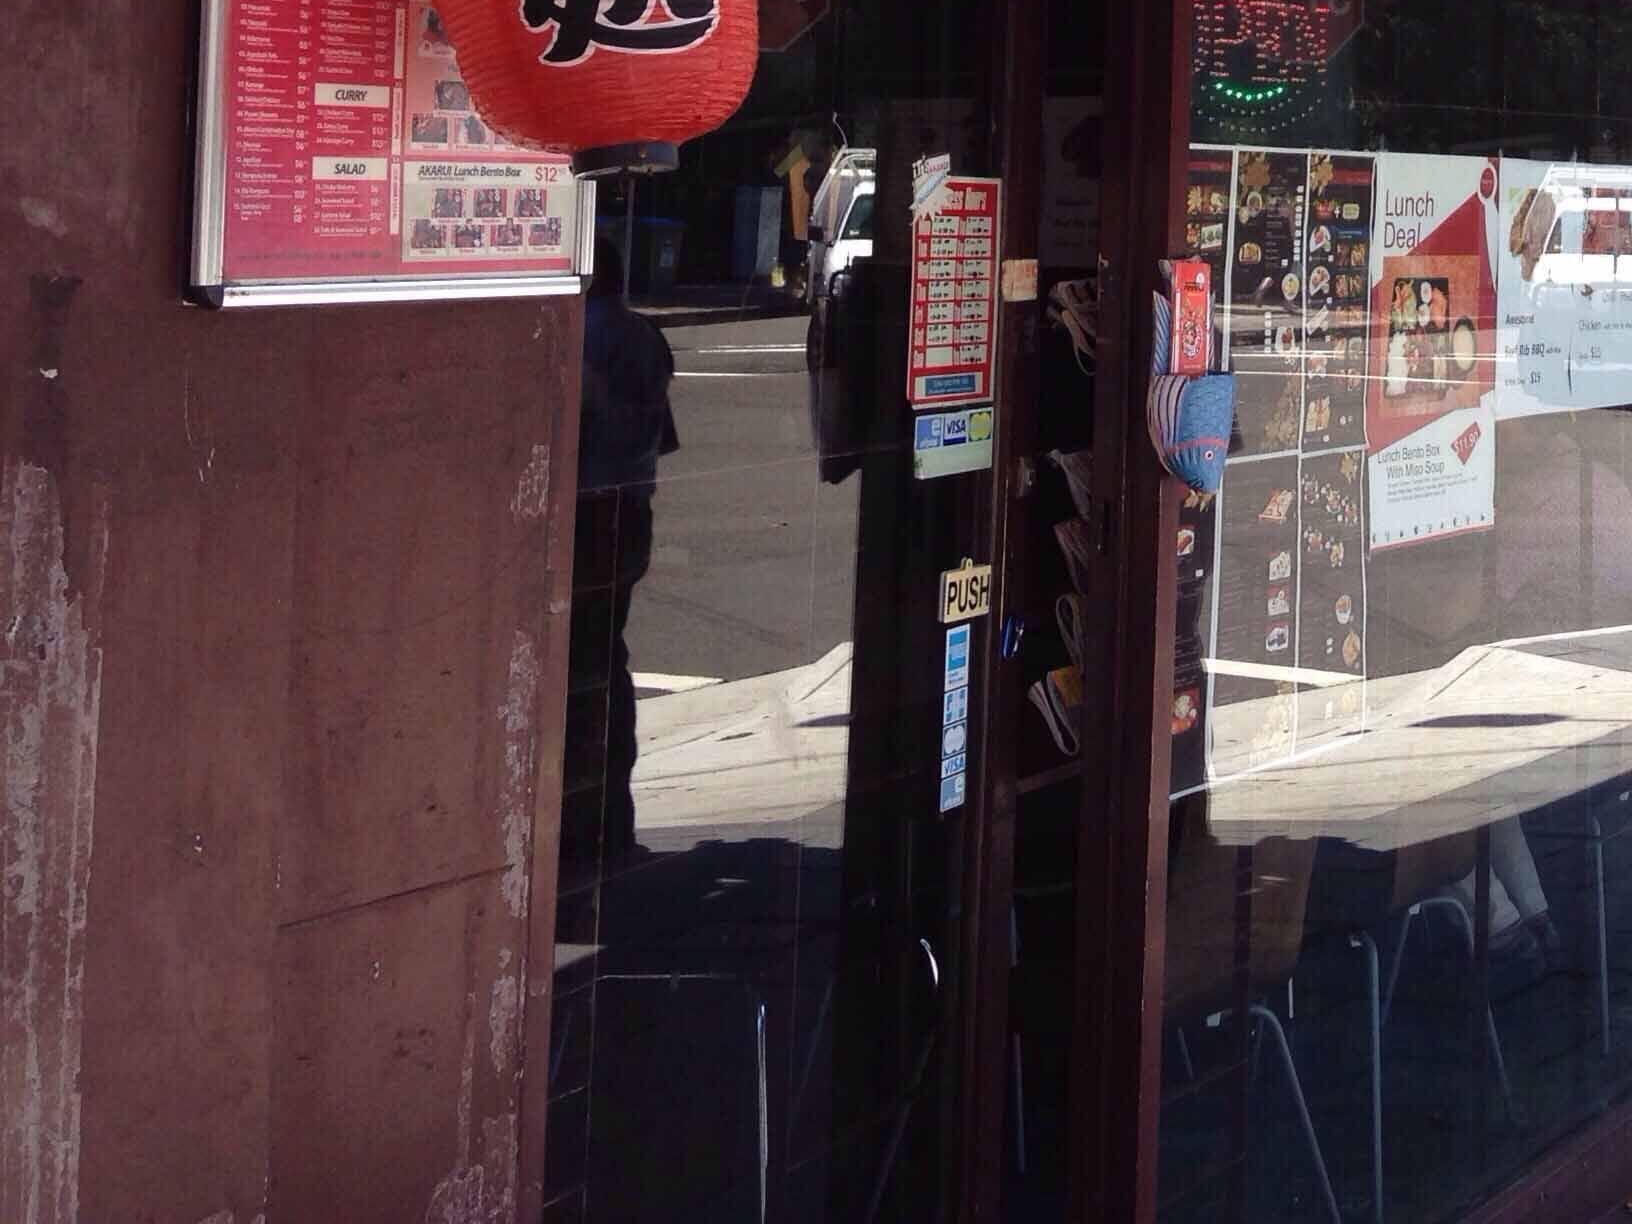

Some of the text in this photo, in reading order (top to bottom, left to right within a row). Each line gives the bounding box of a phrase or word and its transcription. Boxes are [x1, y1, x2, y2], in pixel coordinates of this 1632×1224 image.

[335, 89, 367, 102] CURRY
[334, 163, 366, 176] SALAD
[453, 165, 479, 177] Lunch
[1385, 189, 1434, 217] Lunch
[1383, 222, 1421, 249] Deal
[946, 419, 966, 434] VISA
[1377, 448, 1401, 465] Lunch
[947, 573, 990, 616] PUSH
